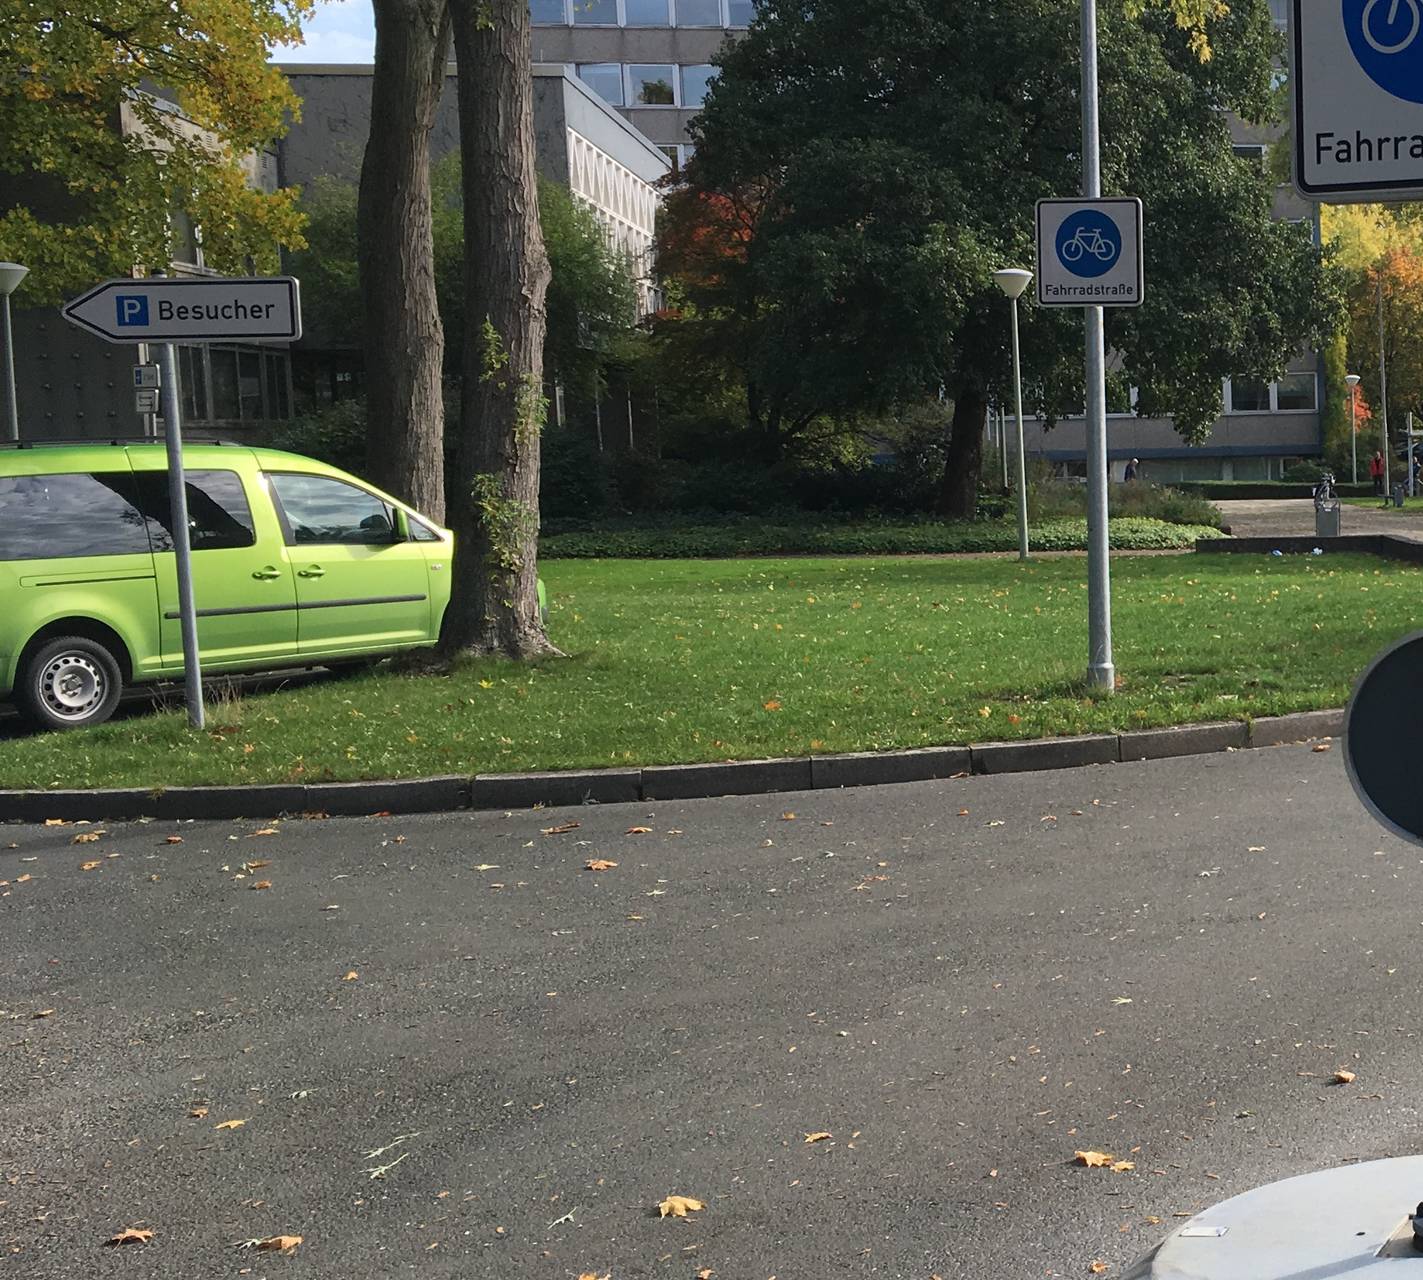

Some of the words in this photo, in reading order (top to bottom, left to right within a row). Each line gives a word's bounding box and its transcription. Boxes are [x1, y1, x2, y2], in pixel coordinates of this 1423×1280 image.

[1046, 284, 1134, 296] Fahrradstraße
[124, 299, 141, 322] P
[159, 299, 275, 321] Besucher
